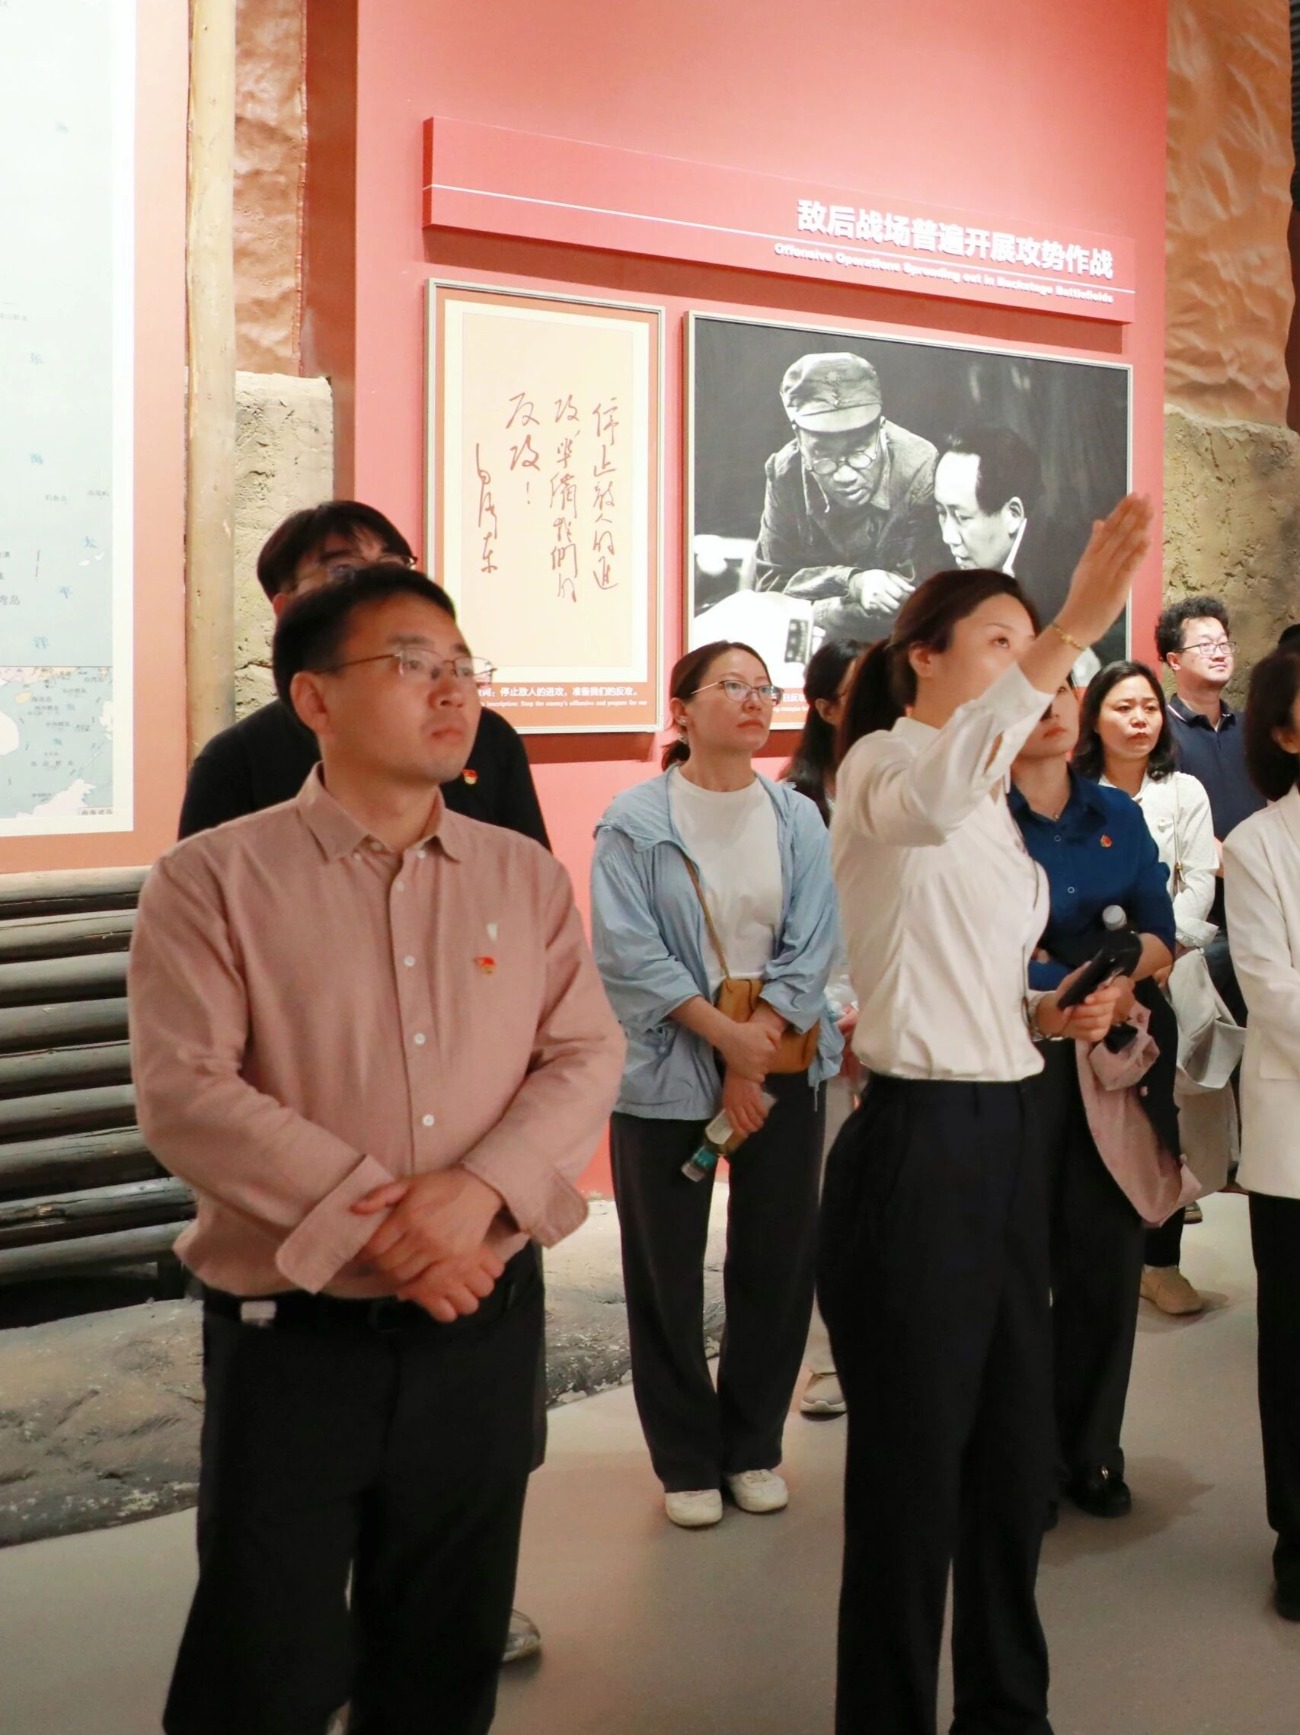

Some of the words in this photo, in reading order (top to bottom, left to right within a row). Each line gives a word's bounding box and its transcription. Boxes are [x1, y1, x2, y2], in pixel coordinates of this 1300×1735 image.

[774, 243, 833, 262] Offensive
[835, 252, 901, 272] Operations
[797, 199, 1114, 279] 敌后战场普遍开展攻势作战
